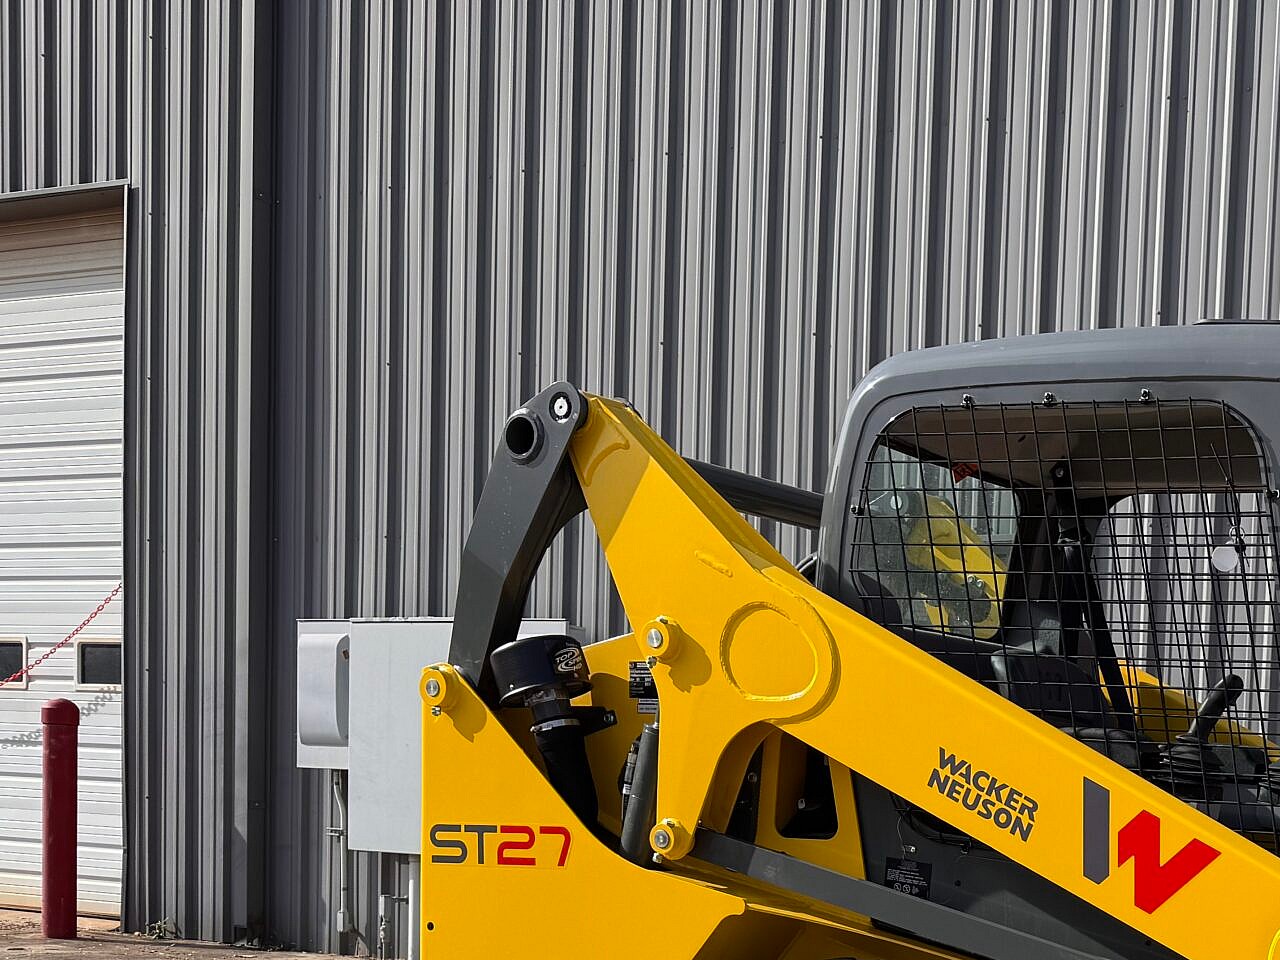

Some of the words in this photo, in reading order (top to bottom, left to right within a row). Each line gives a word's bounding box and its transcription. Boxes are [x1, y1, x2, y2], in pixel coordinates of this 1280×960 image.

[555, 652, 573, 663] TOP
[927, 768, 1034, 842] NEUSON
[939, 746, 1039, 823] WACKER
[430, 824, 571, 866] ST27
